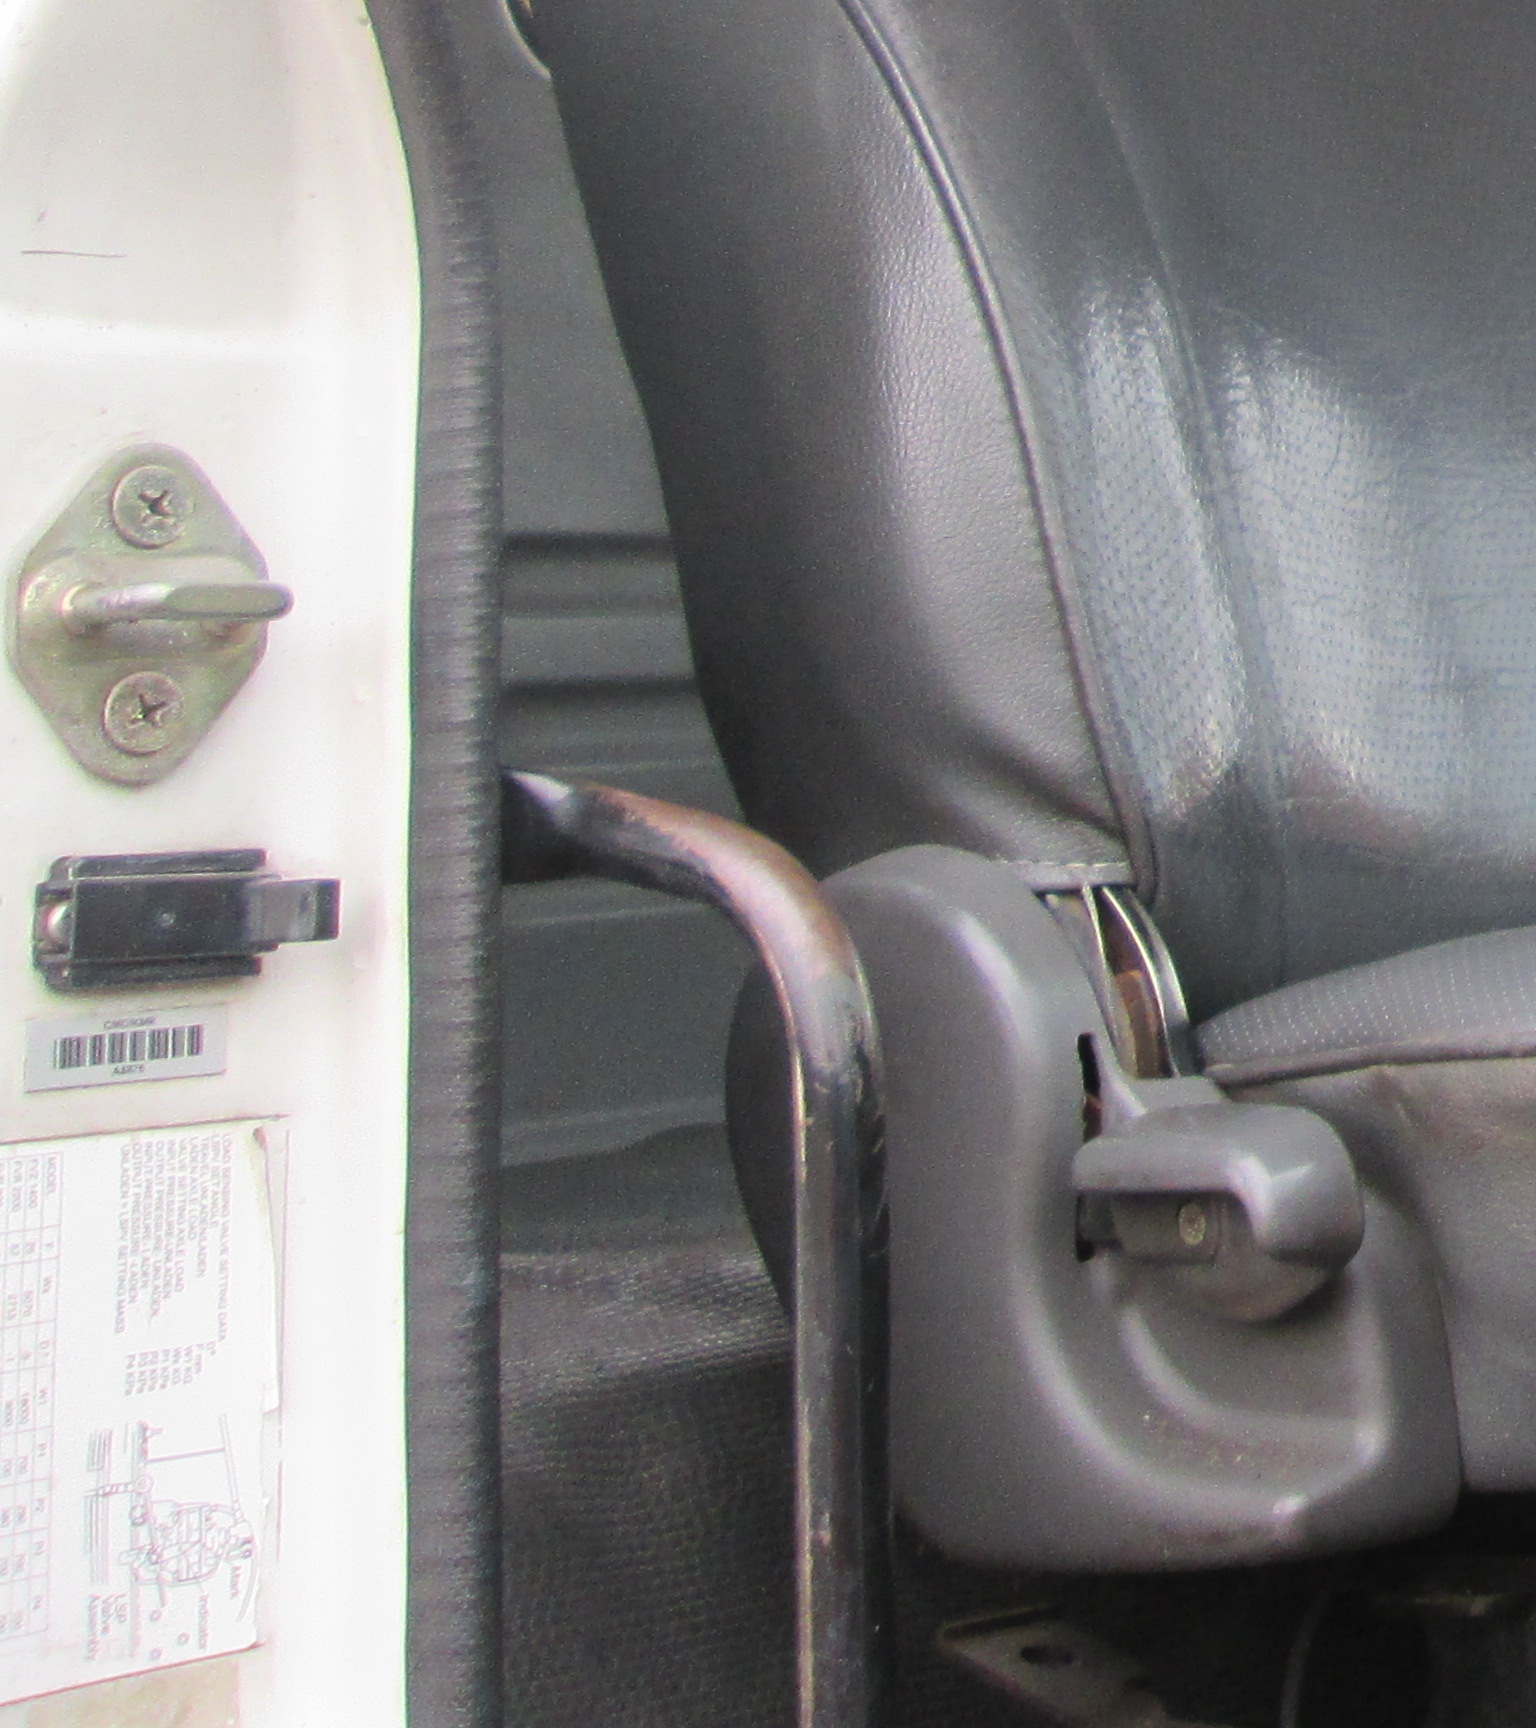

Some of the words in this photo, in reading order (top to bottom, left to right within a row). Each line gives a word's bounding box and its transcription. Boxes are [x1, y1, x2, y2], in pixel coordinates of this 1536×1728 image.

[133, 1143, 142, 1189] OUTPUT
[144, 1142, 153, 1174] INPUT
[155, 1141, 165, 1186] OUTPUT
[166, 1140, 176, 1172] INPUT
[178, 1138, 188, 1172] VALVE
[189, 1137, 199, 1174] LADEN
[200, 1137, 210, 1178] TRAVEL
[222, 1133, 232, 1163] LOAD
[46, 1157, 57, 1196] MODEL
[120, 1144, 131, 1199] UNLADEN
[211, 1166, 220, 1187] SET
[177, 1176, 187, 1225] SETTING
[188, 1176, 198, 1205] AXLE
[210, 1190, 219, 1228] ANGLE
[221, 1166, 231, 1217] SENSING
[130, 1193, 142, 1256] PRESSURE
[142, 1178, 153, 1241] PRESSURE
[188, 1208, 198, 1241] LOAD
[175, 1228, 186, 1256] AXLE
[219, 1220, 230, 1256] VALVE
[116, 1245, 128, 1296] SETTING
[140, 1248, 151, 1289] LADEN
[174, 1260, 185, 1292] LOAD
[218, 1260, 229, 1309] SETTING
[151, 1260, 161, 1318] UNLADEN
[115, 1299, 127, 1333] MASS
[217, 1312, 228, 1343] DATA
[172, 1368, 181, 1385] KG
[183, 1367, 193, 1384] KG
[230, 1566, 242, 1600] Mark
[101, 1595, 115, 1635] Valve
[115, 1592, 128, 1623] LSP
[198, 1594, 210, 1650] Indicator
